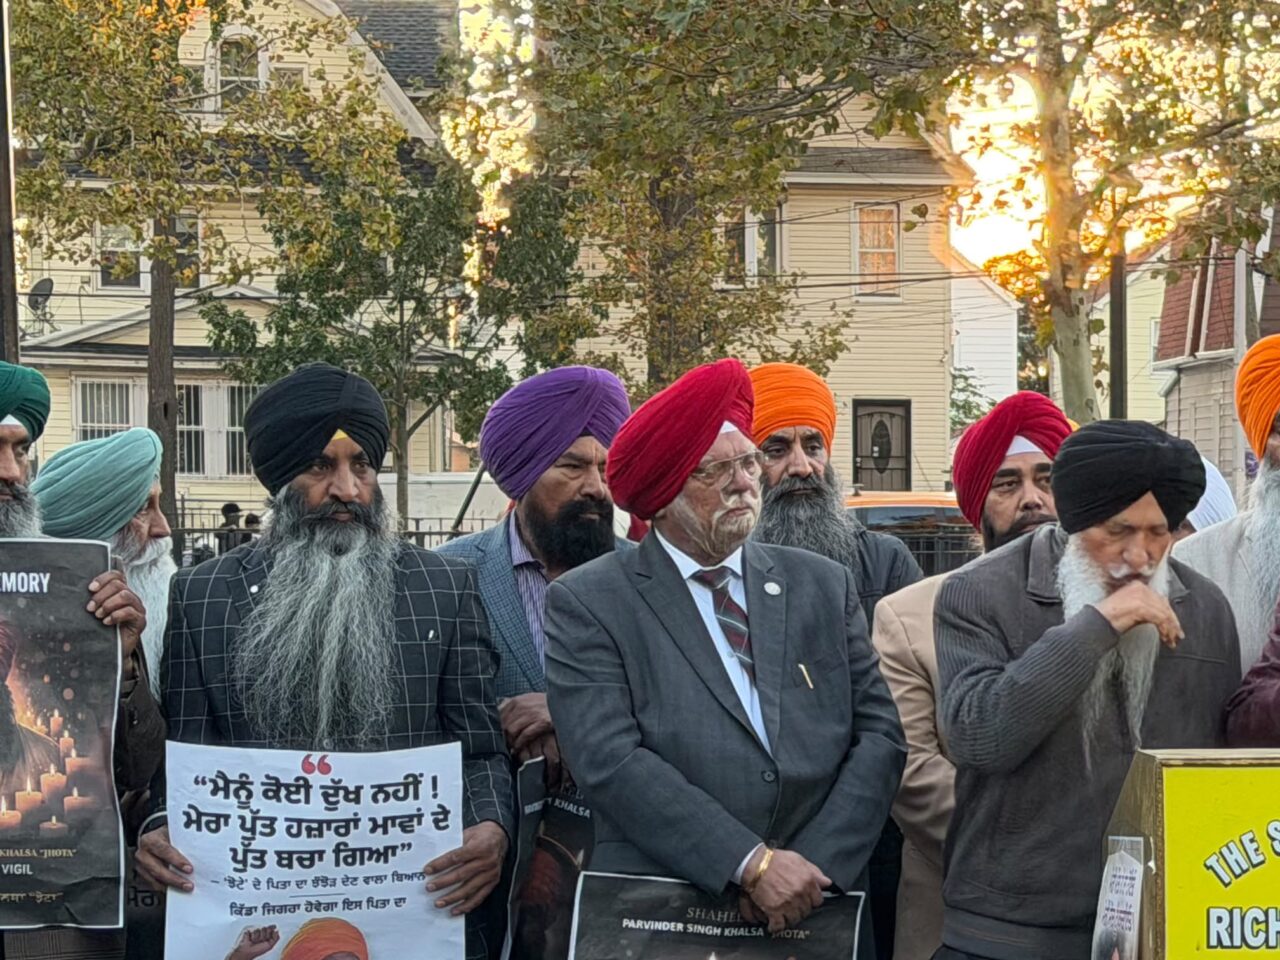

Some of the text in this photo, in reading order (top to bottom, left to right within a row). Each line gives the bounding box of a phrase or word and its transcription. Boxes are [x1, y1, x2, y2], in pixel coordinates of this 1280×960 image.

[261, 774, 312, 804] ਕੋਈ
[319, 778, 363, 811] ਦੁੱਖ
[370, 772, 424, 804] ਨਹੀਂ
[182, 804, 451, 842] ਮੇਰਾ ਪੁੱਤ ਹਜ਼ਾਰਾਂ ਮਾਵਾਂ ਦੇ
[1, 864, 34, 875] VIGIL
[230, 840, 268, 872] ਪੁੱਤ
[275, 849, 326, 869] ਬਚਾ
[1203, 831, 1267, 888] THE
[622, 918, 766, 938] PARVINDER SINGH KHALSA
